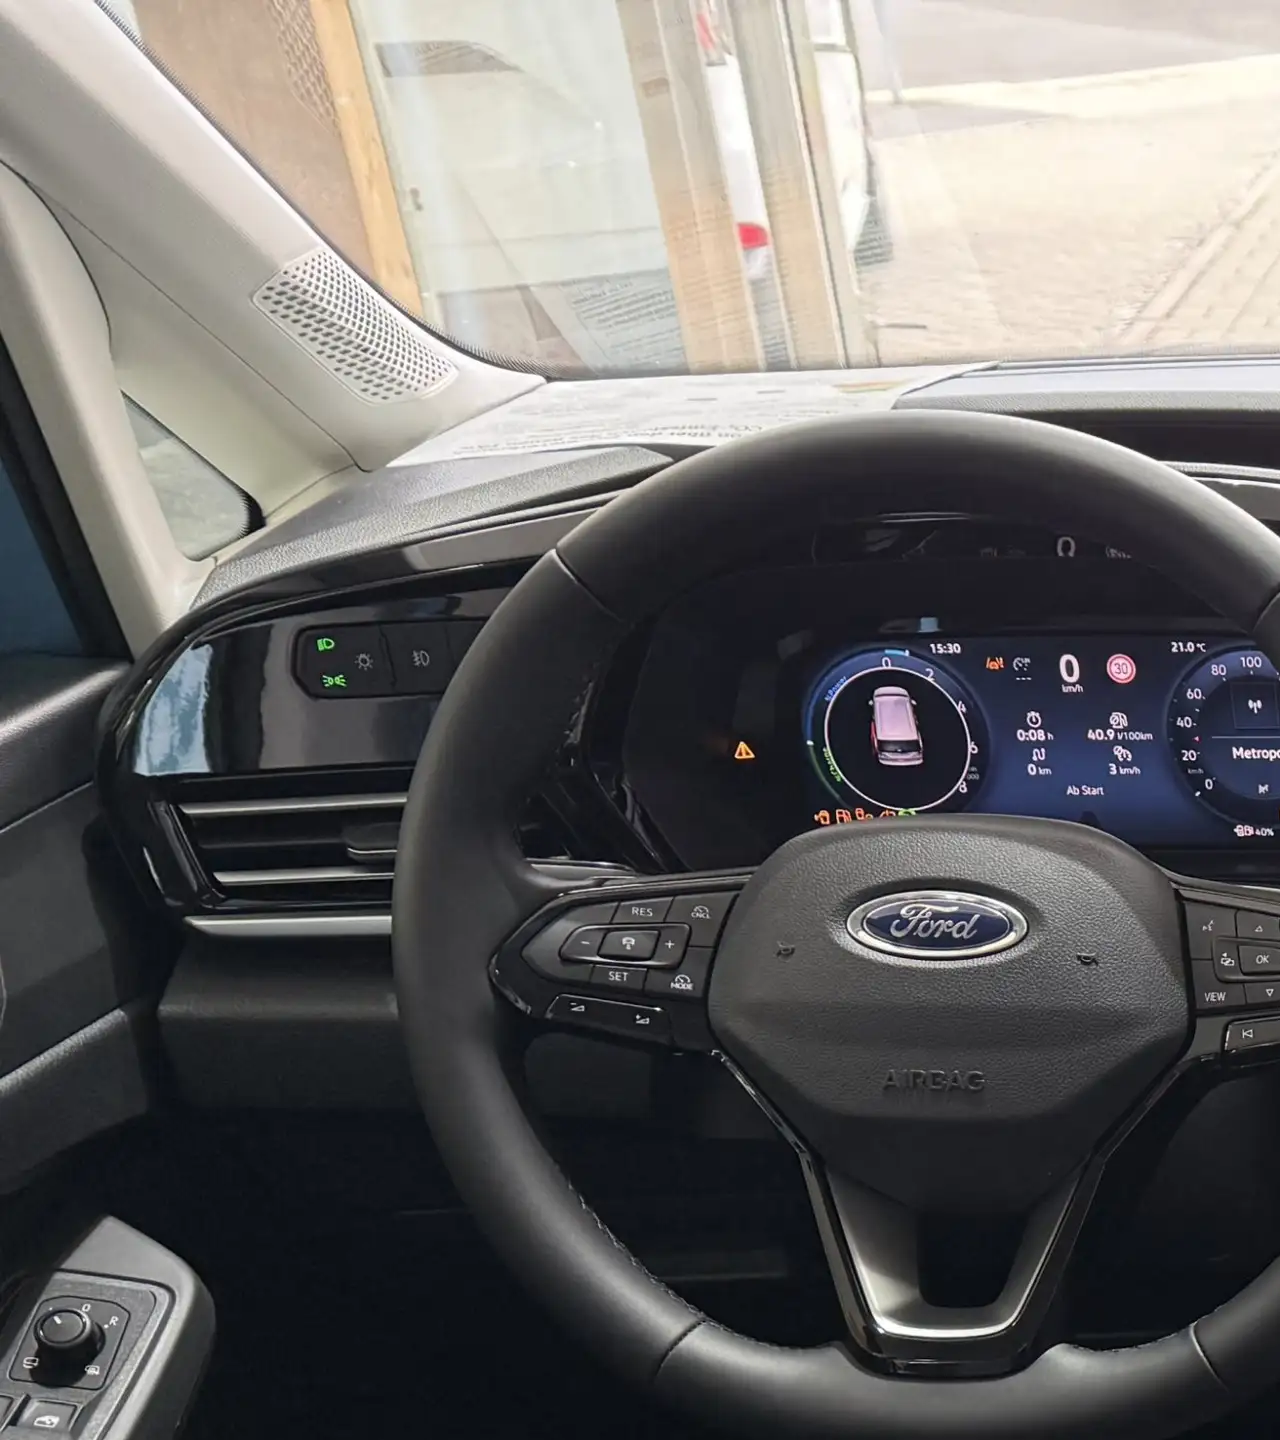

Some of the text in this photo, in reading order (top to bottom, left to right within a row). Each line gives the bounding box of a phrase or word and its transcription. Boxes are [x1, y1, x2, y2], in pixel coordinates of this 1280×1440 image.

[929, 643, 961, 654] 15:30
[1171, 642, 1194, 653] 21.0
[1240, 656, 1262, 668] 100
[1059, 654, 1080, 683] 0
[1114, 663, 1128, 675] 30
[1211, 664, 1226, 676] 80
[1062, 684, 1083, 693] km/h
[1186, 688, 1202, 700] 60
[1176, 716, 1192, 728] 40
[1016, 729, 1045, 741] 0:08
[1087, 729, 1115, 741] 40.9
[1181, 750, 1197, 761] 20
[1027, 763, 1052, 775] 0 km
[1109, 764, 1141, 775] 3 km/h
[1205, 779, 1213, 790] 0
[1066, 786, 1104, 795] Ab Start
[631, 906, 653, 917] RES
[890, 903, 980, 939] Ford
[1255, 954, 1270, 965] OK
[608, 971, 629, 982] SET
[670, 982, 694, 991] MODE
[1204, 991, 1227, 1002] VIEW
[882, 1069, 985, 1091] AIRBAG
[110, 1316, 119, 1326] R
